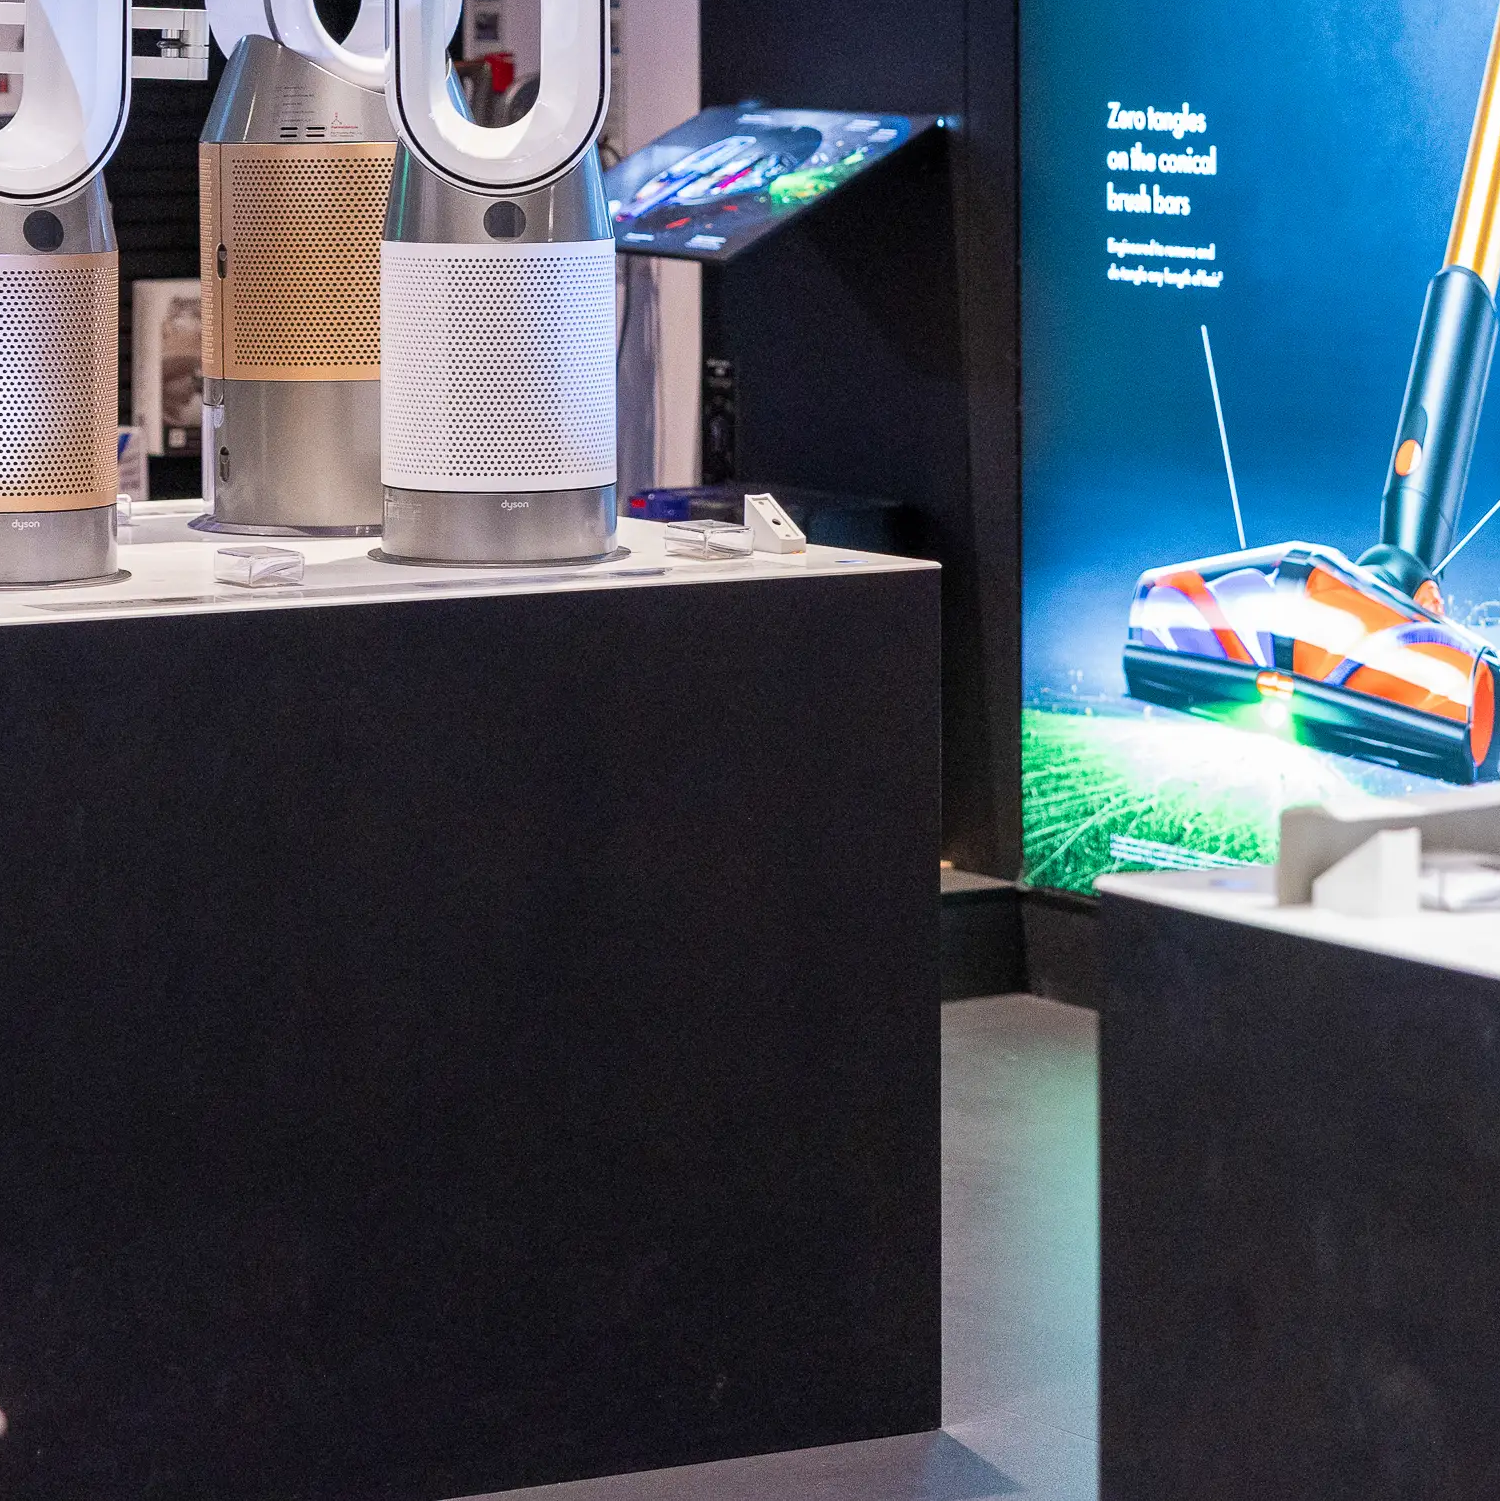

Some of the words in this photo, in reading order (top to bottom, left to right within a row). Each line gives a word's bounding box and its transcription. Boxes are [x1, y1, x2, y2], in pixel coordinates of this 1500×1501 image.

[1106, 101, 1147, 130] Zero
[1147, 102, 1207, 140] tangles
[1106, 150, 1130, 171] on
[1130, 141, 1157, 173] the
[1157, 145, 1218, 176] conical
[1106, 181, 1152, 213] brush
[1152, 183, 1191, 216] bars
[500, 499, 530, 511] dyson
[11, 518, 41, 531] dyson
